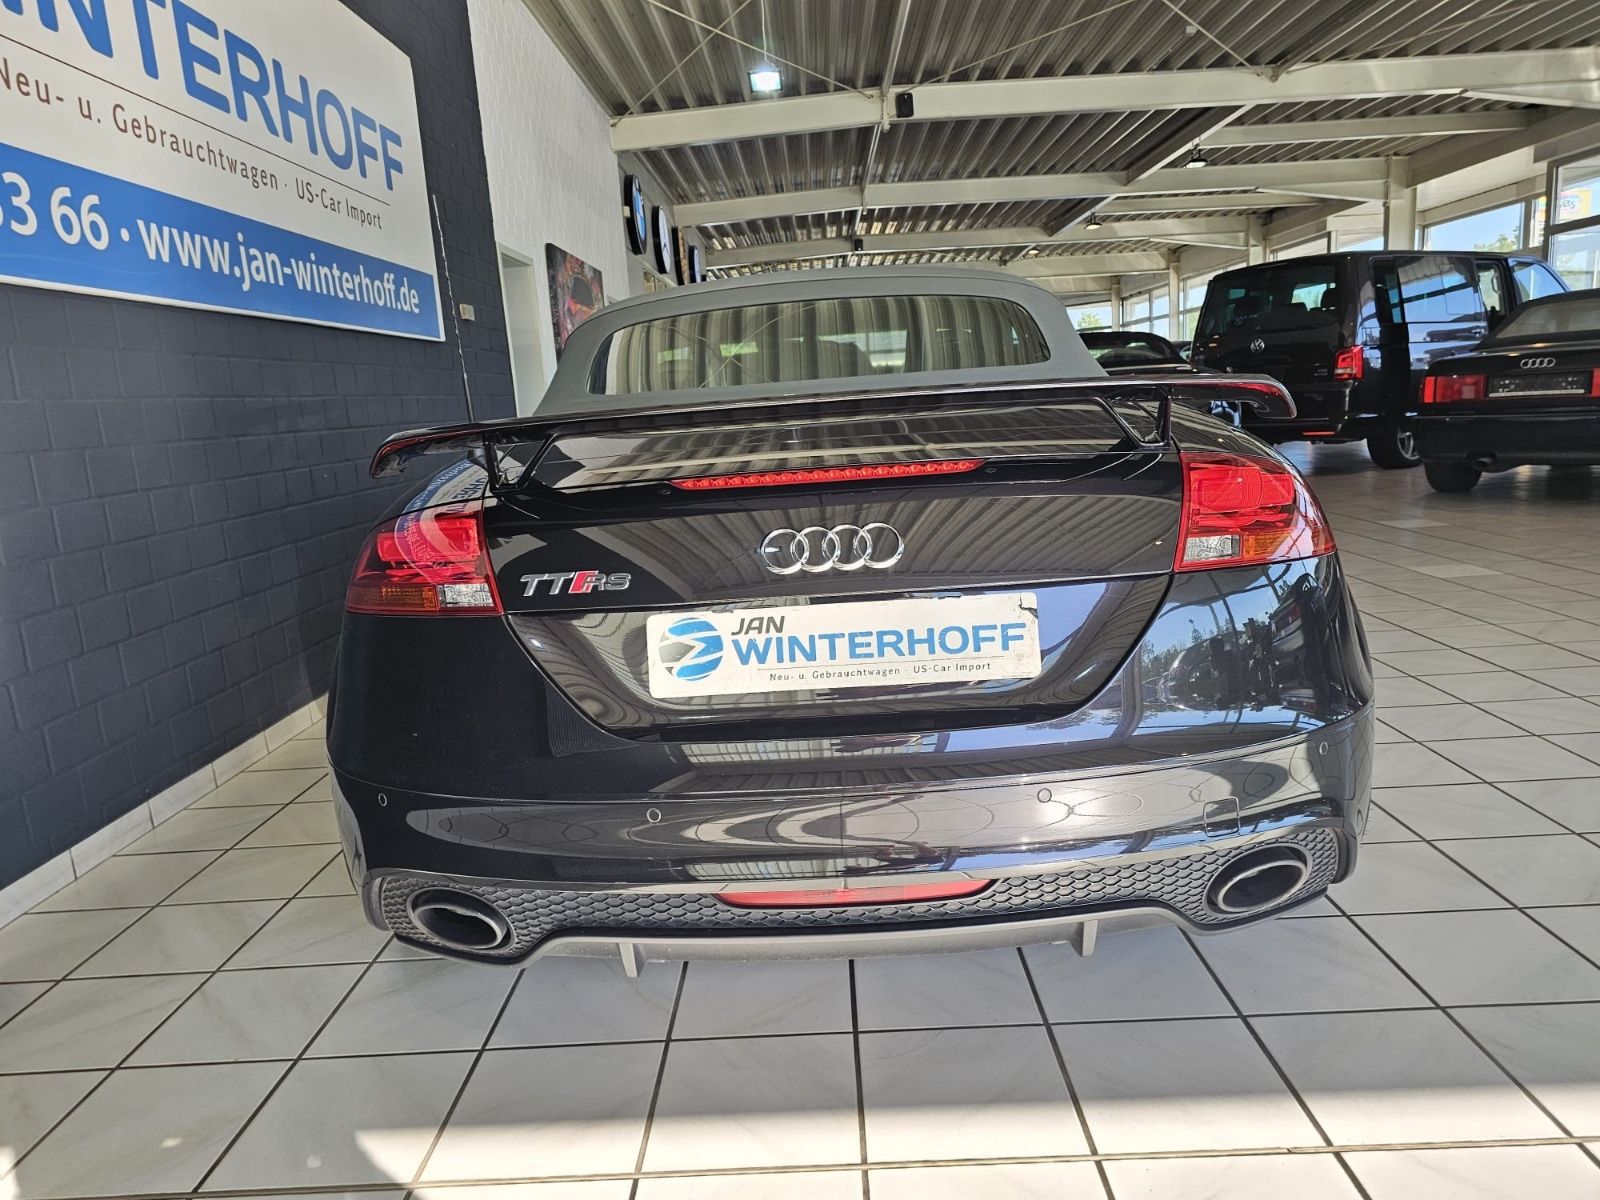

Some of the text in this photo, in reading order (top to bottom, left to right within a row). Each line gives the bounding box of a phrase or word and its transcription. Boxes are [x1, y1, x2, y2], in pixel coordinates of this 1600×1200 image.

[0, 0, 404, 192] TERHOFF
[78, 96, 102, 124] u.
[112, 103, 279, 191] Gebrauchtwagen
[295, 177, 342, 214] US-Car
[346, 198, 383, 230] Import
[0, 171, 421, 315] 3 66 www.jan-winterhoff.de
[731, 615, 786, 636] JAN
[731, 622, 1027, 666] WINTERHOFF
[769, 672, 795, 682] Neu-
[812, 667, 901, 680] Gebrauchtwagen
[913, 664, 951, 674] US-Car
[955, 662, 992, 673] Import
